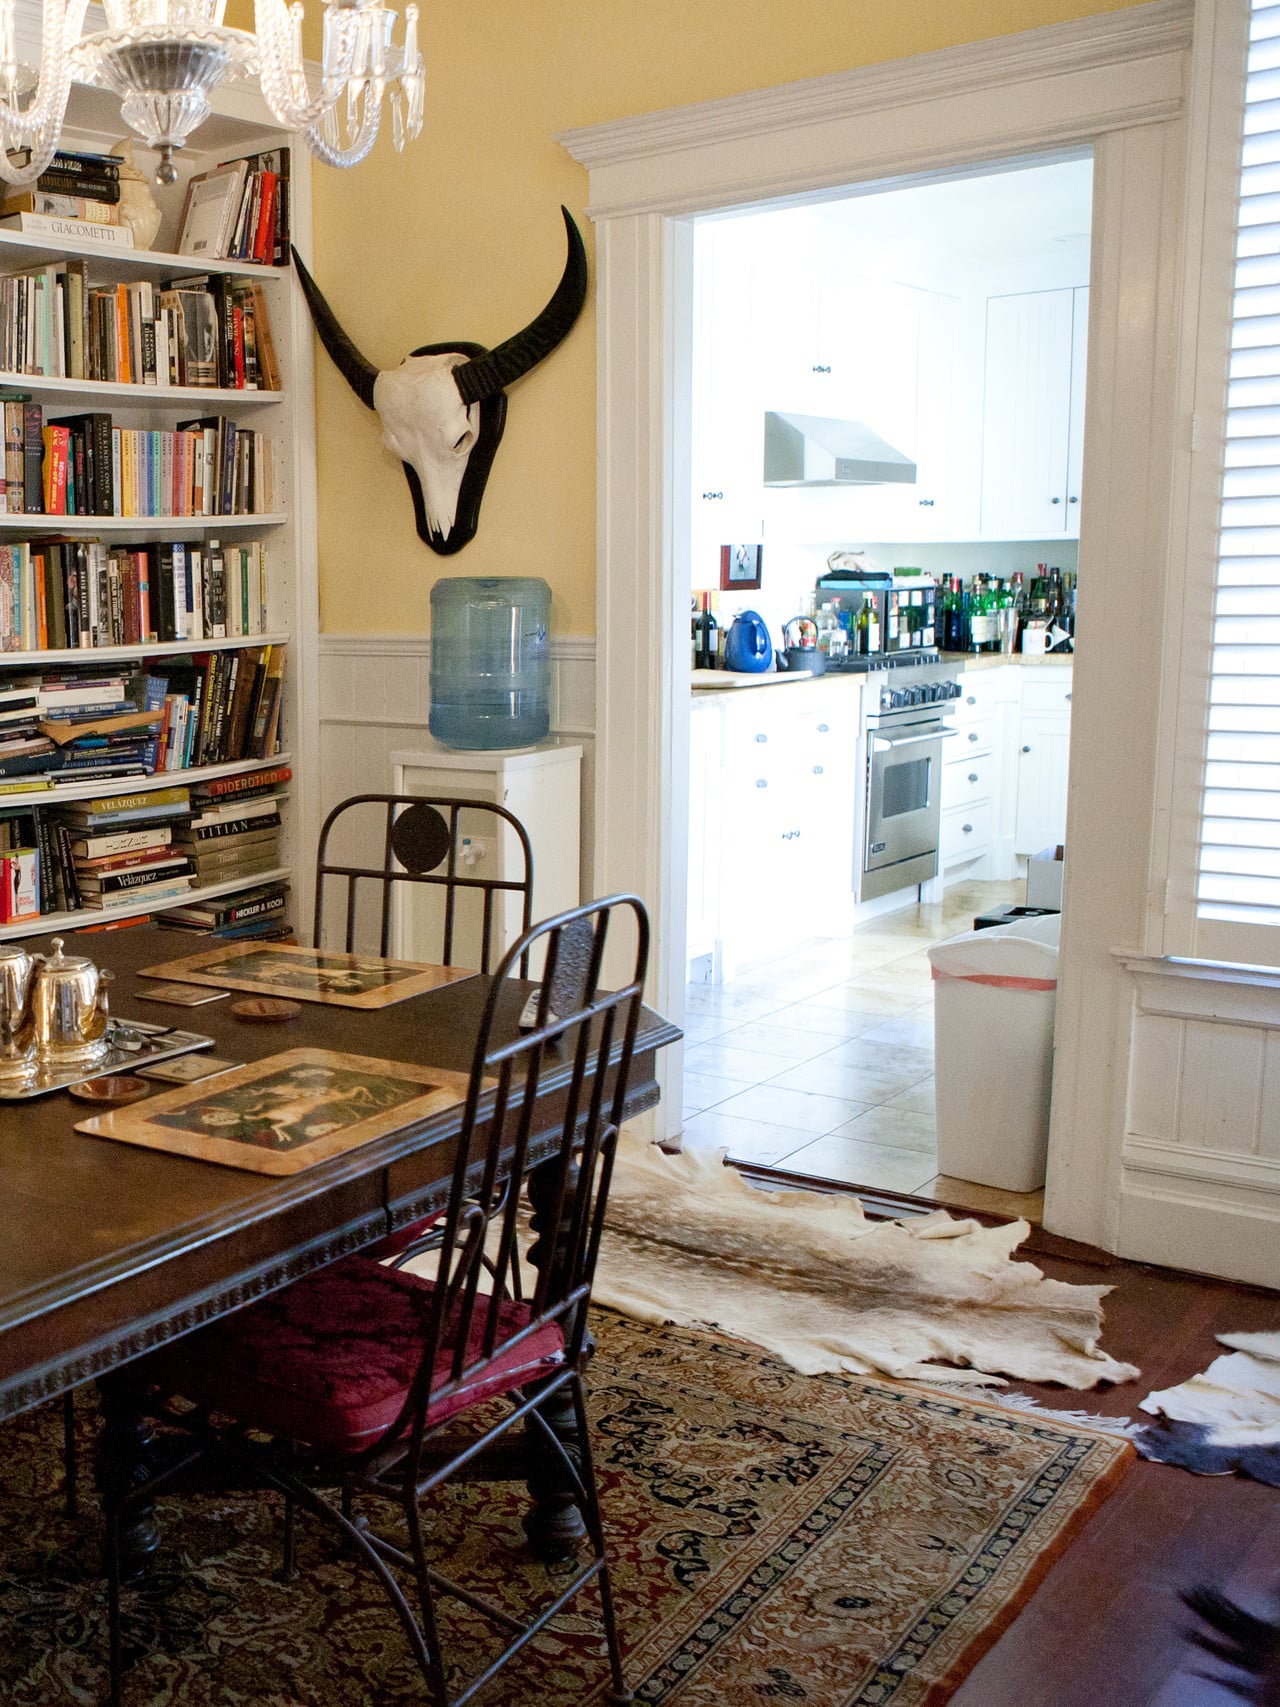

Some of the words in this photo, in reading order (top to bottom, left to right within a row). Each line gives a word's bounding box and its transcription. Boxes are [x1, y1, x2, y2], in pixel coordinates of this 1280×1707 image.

[51, 221, 116, 241] GIACOMETTI
[101, 797, 147, 810] VELÁZQUEZ
[199, 821, 249, 839] TITIAN
[117, 873, 157, 887] Velázquez
[235, 906, 260, 918] HECKLER
[267, 899, 284, 910] KOCH
